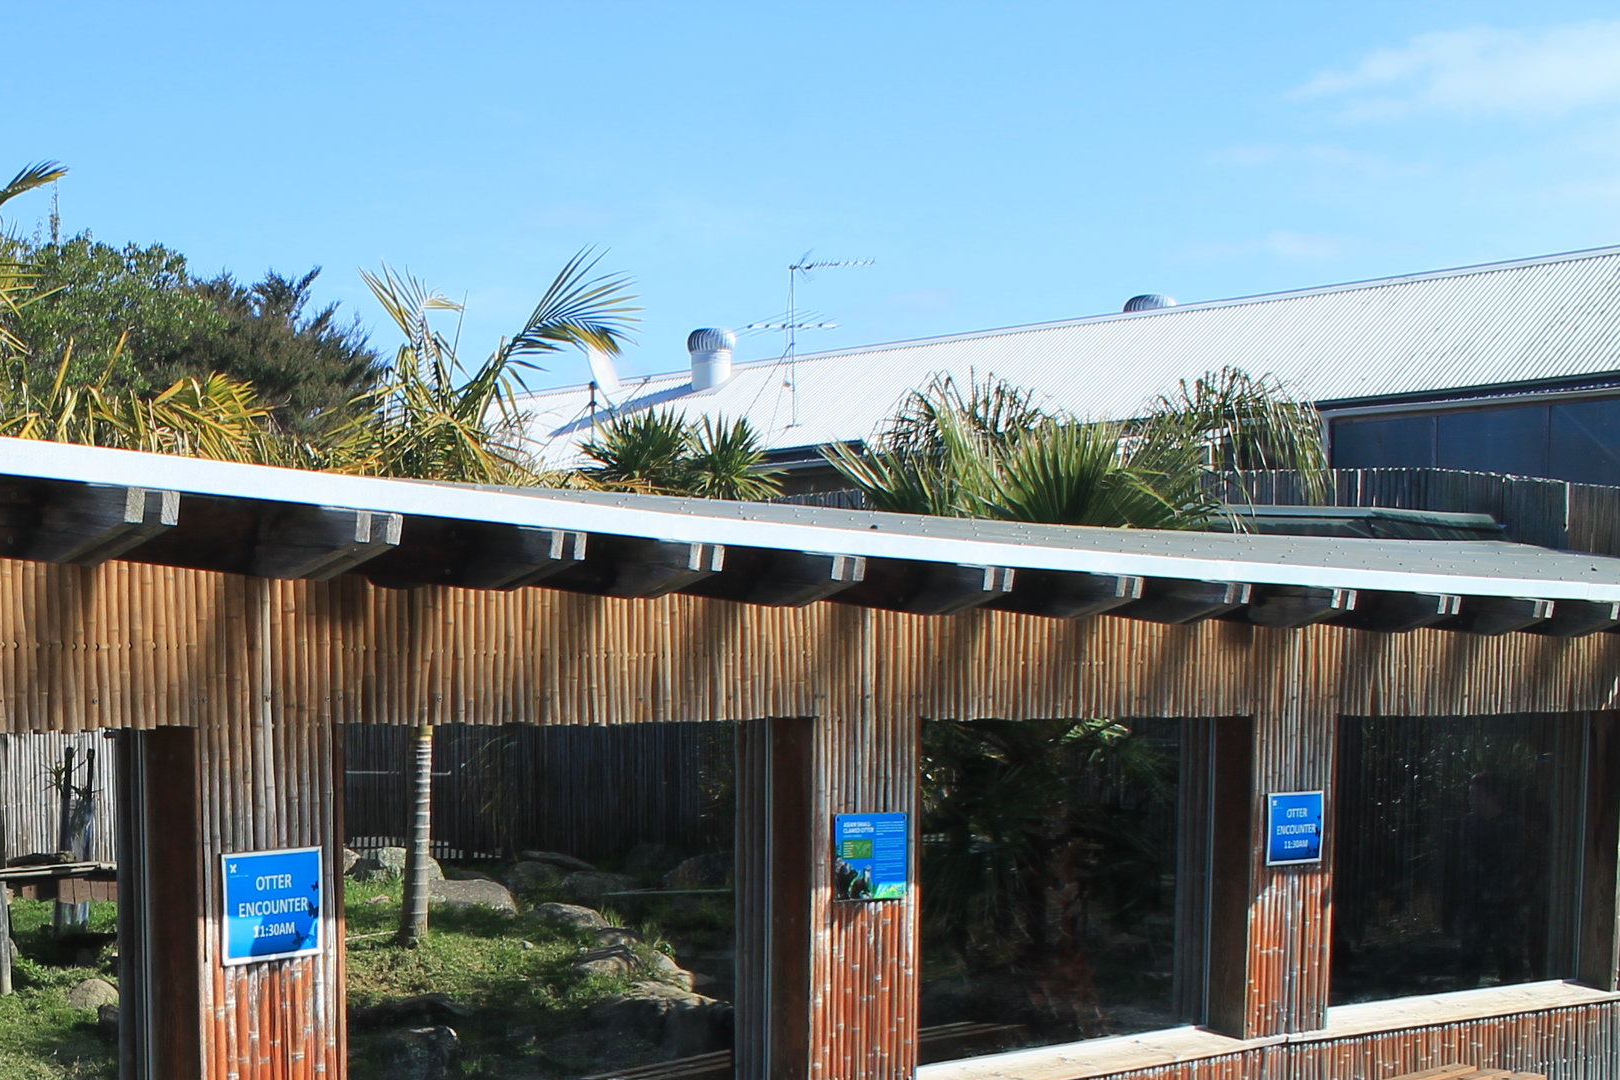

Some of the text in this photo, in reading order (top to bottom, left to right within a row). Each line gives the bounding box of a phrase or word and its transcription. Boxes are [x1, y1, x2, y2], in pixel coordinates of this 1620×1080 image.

[1287, 808, 1307, 818] OTTER
[1277, 824, 1316, 835] ENCOUNTER
[255, 874, 292, 891] OTTER
[238, 896, 309, 918] ENCOUNTER
[253, 921, 295, 938] 11:30AM
